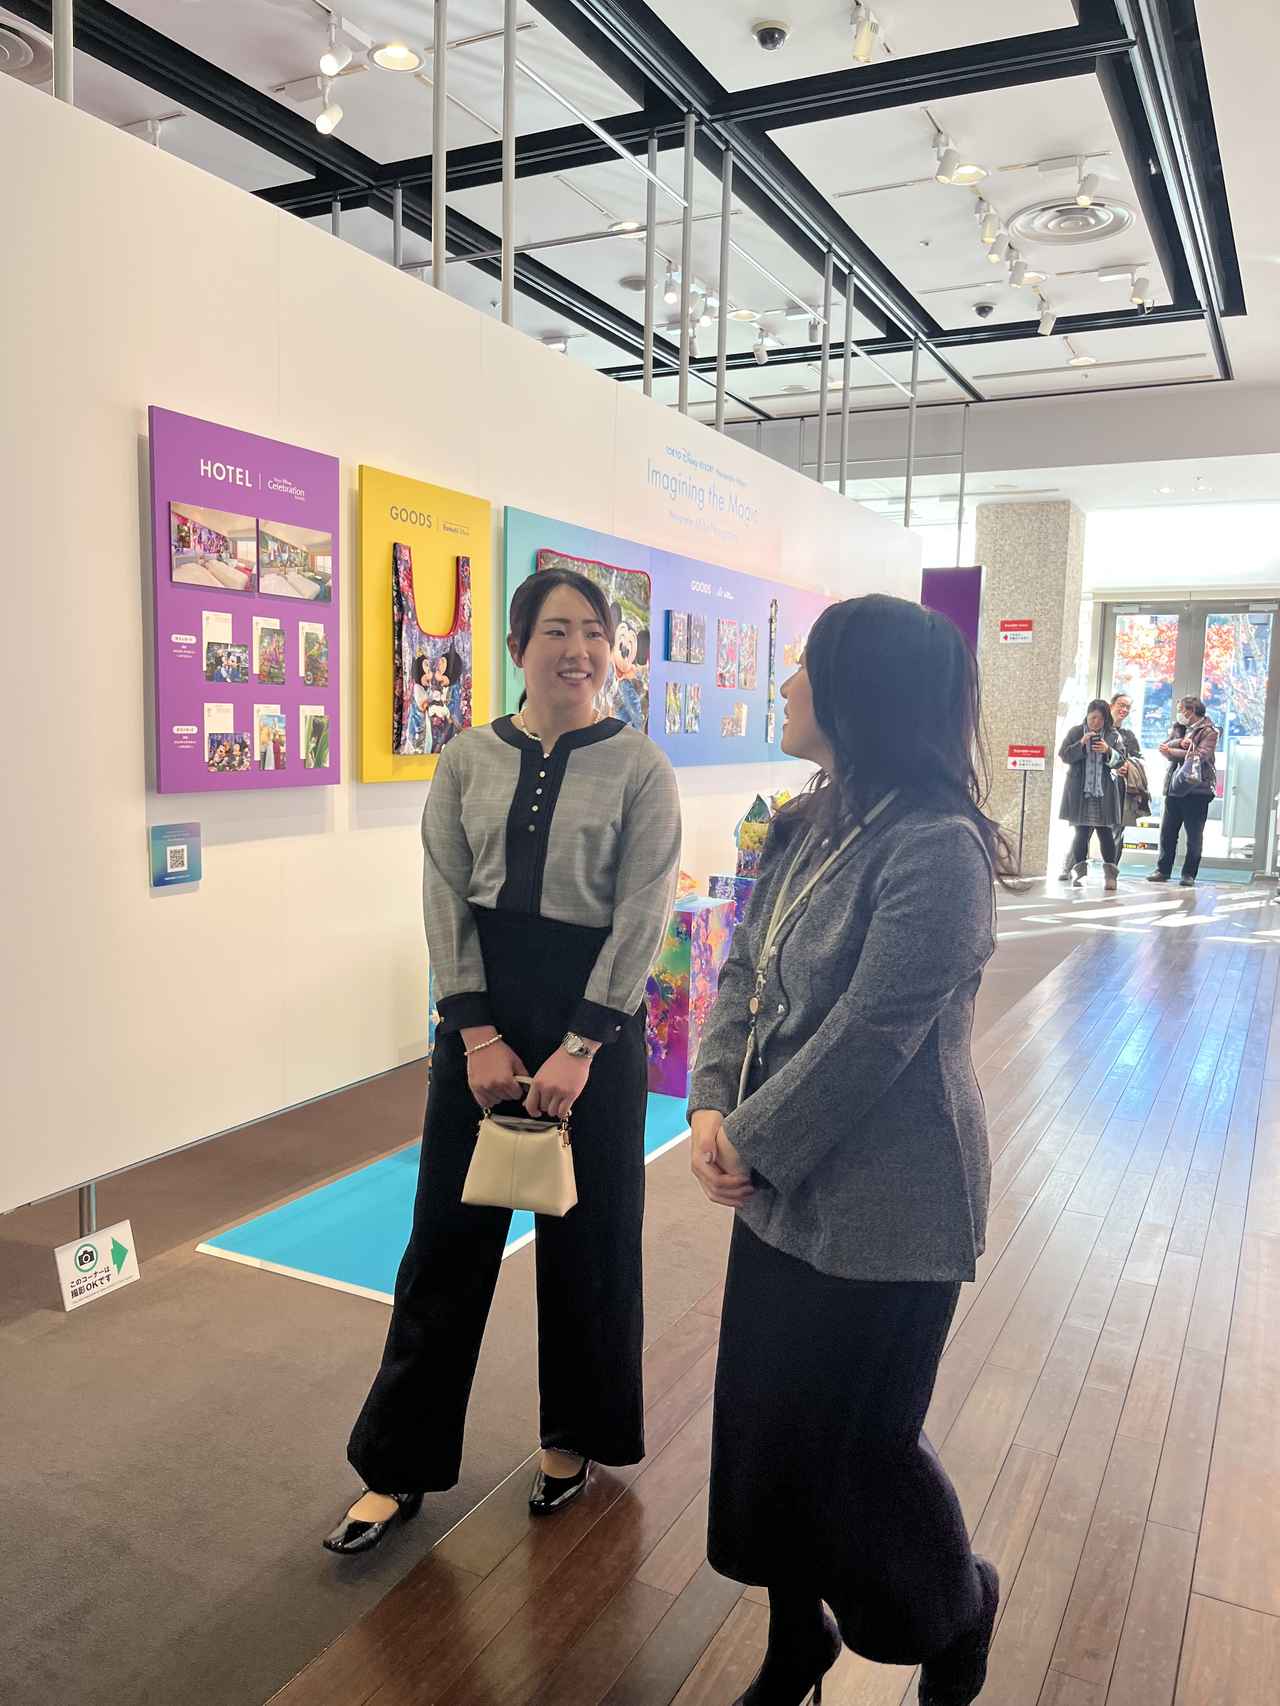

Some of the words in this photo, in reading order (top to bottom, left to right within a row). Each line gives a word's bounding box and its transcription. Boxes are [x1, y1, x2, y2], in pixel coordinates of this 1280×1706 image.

[200, 458, 252, 487] HOTEL
[647, 458, 705, 511] Imagining
[708, 481, 725, 512] the
[267, 479, 305, 497] Celebration
[390, 505, 432, 529] GOODS
[70, 1265, 111, 1288] このコーナーは
[70, 1273, 112, 1299] 撮影OKです
